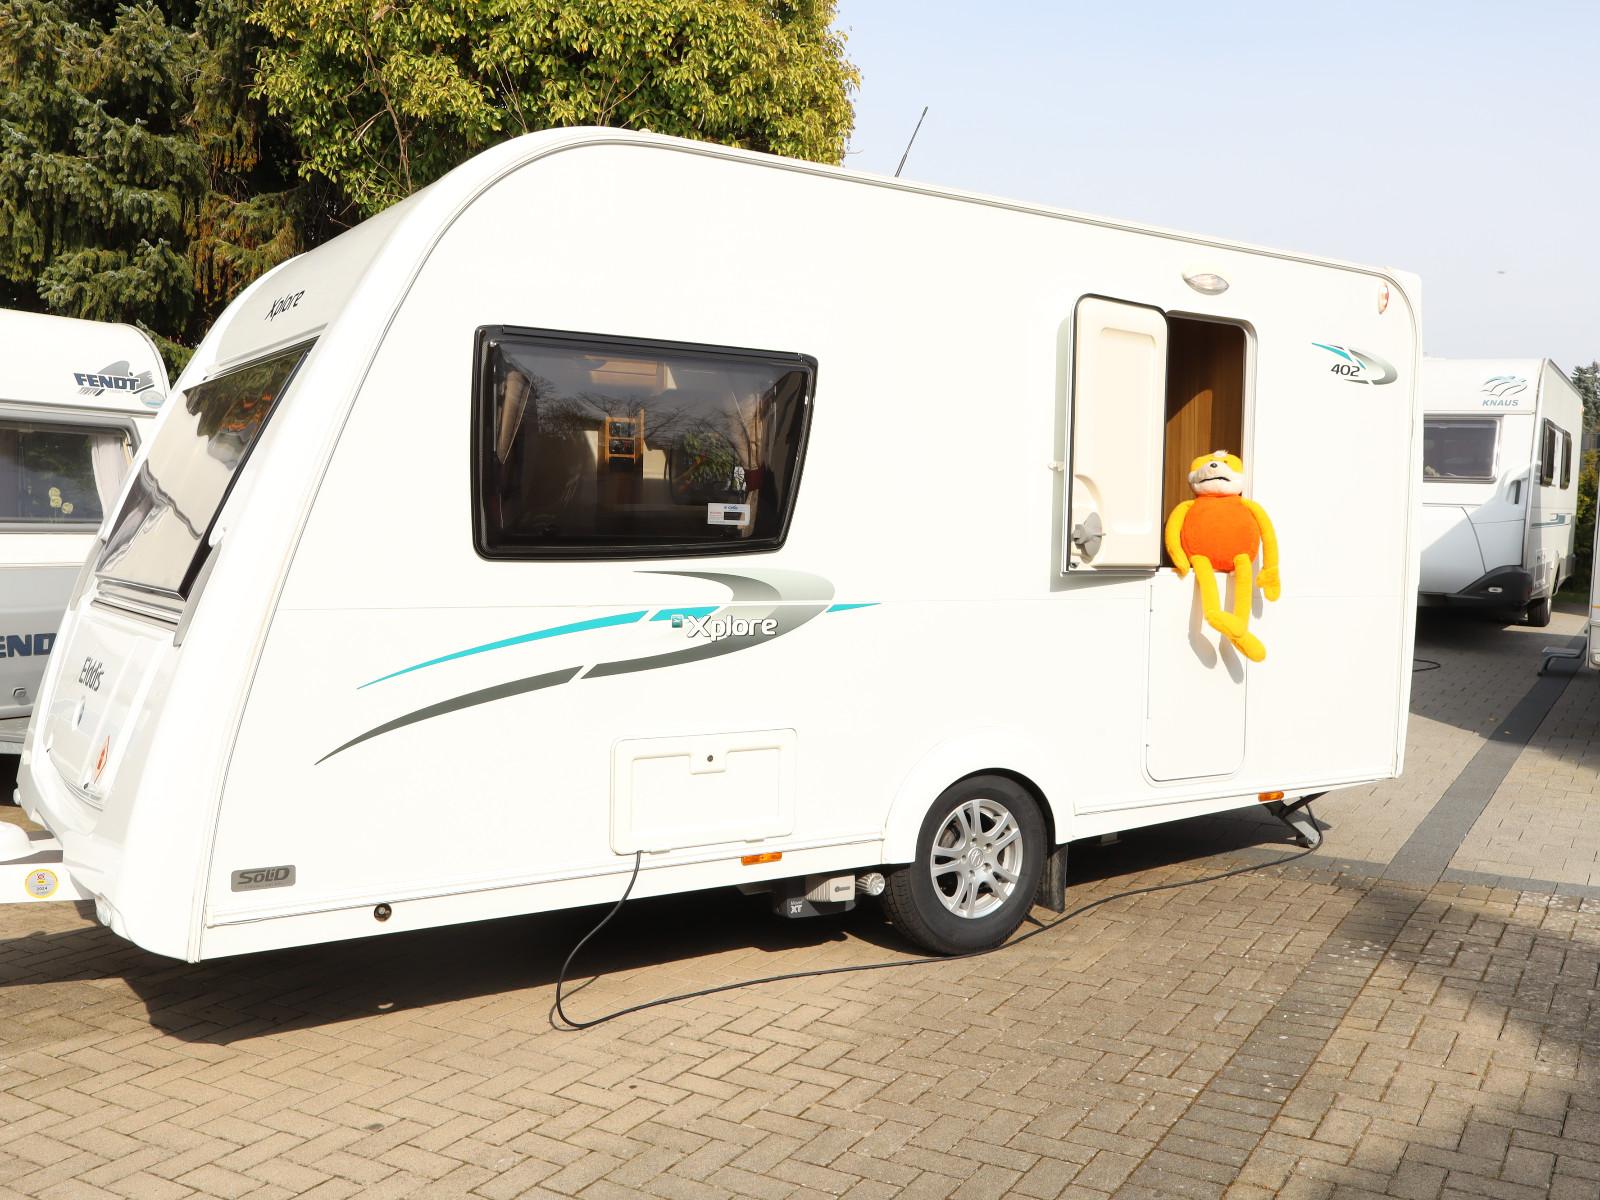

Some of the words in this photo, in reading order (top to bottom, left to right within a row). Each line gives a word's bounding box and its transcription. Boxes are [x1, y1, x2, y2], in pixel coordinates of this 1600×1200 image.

[263, 290, 305, 322] Xplore
[1331, 364, 1361, 377] 402
[74, 372, 140, 391] FENDT
[1481, 399, 1519, 407] KNAUS
[687, 615, 778, 642] Xplore
[78, 656, 105, 692] Elddis
[790, 905, 803, 914] XT
